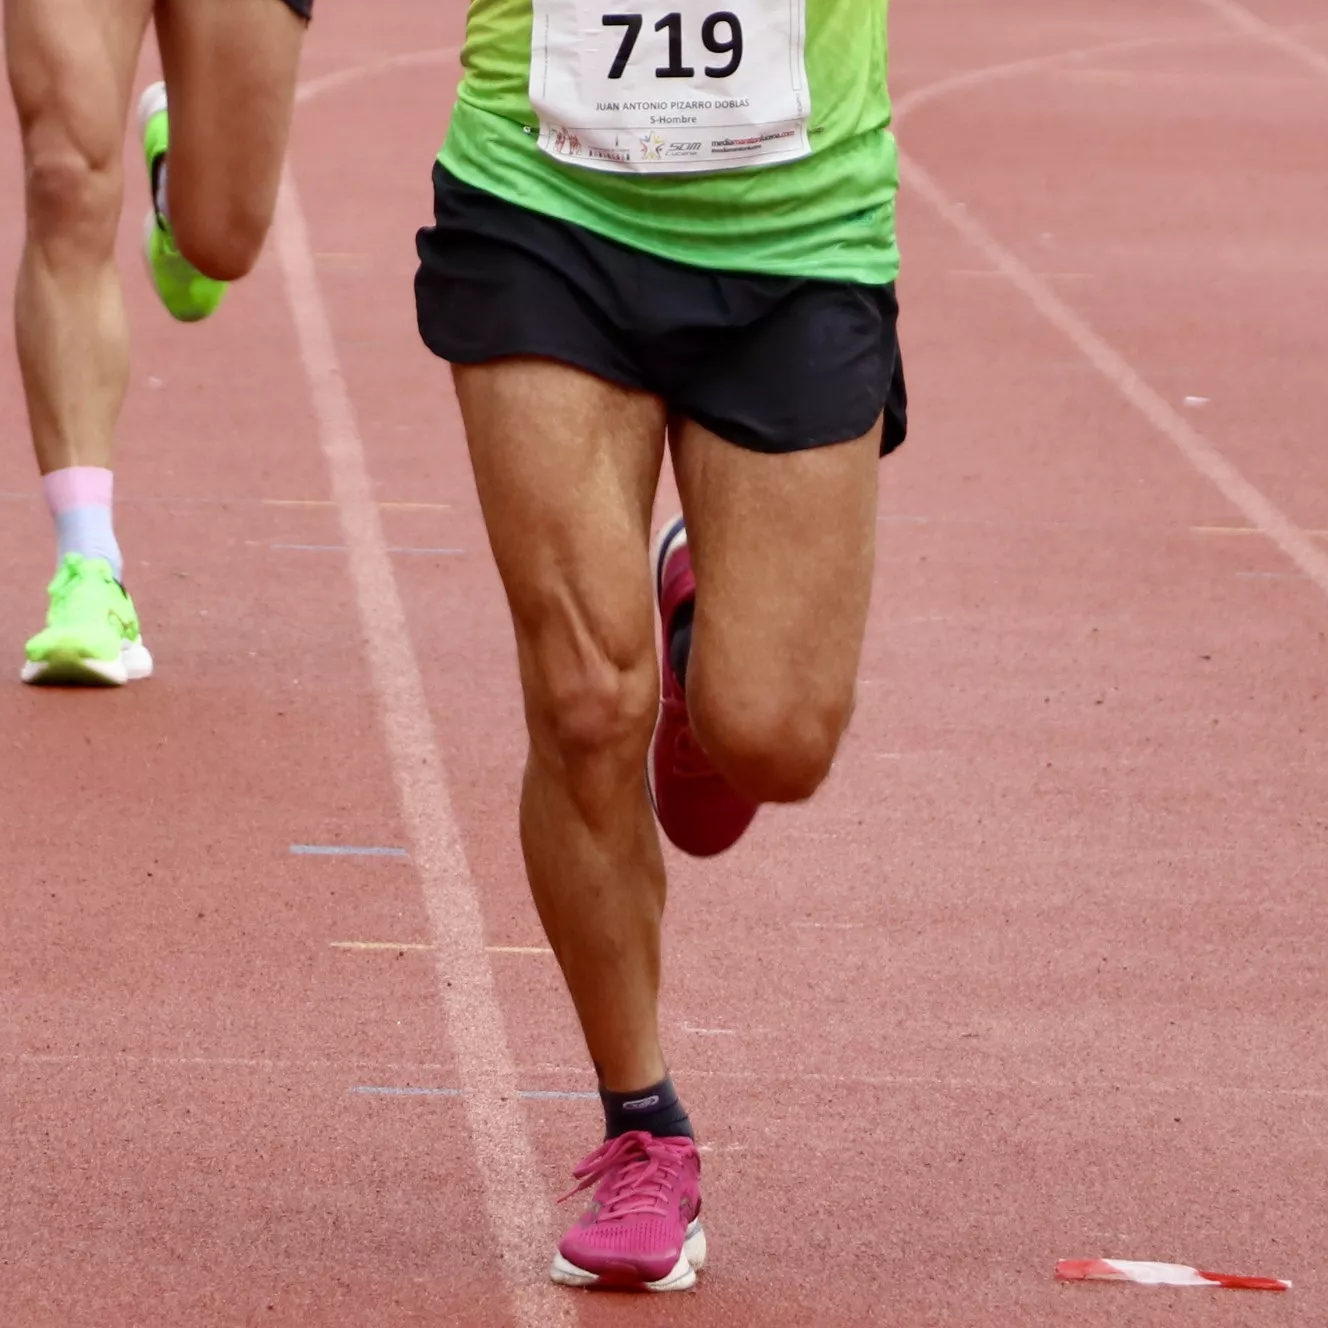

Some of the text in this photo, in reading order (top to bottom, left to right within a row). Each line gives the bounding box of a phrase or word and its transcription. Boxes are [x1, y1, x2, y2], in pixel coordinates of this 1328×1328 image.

[600, 10, 744, 80] 719
[595, 99, 750, 112] JUAN ANTONIO PIZARRO DOBLAS
[650, 115, 697, 125] S-Hombre
